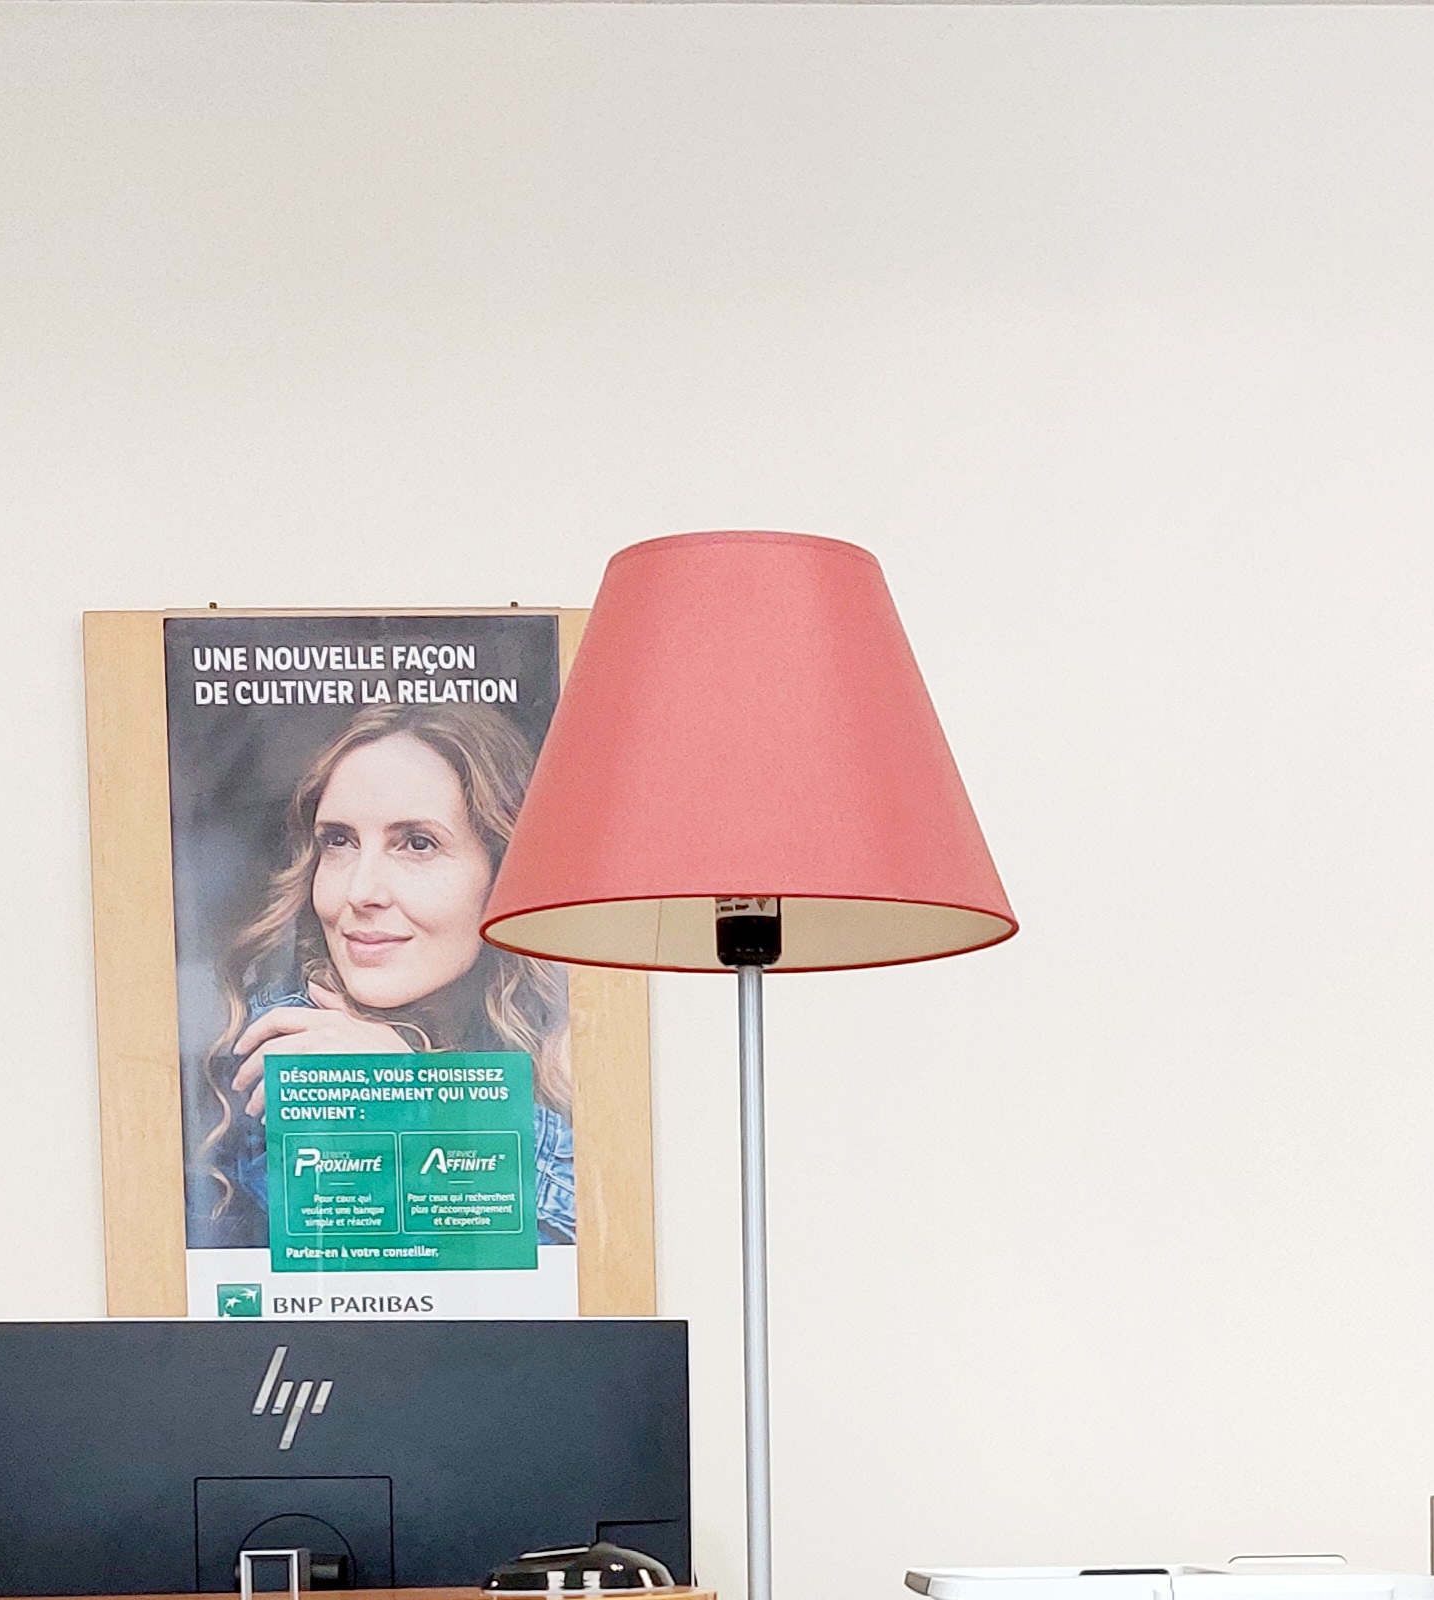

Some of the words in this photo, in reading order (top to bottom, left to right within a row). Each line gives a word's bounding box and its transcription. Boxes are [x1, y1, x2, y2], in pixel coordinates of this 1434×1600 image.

[193, 646, 247, 672] UNE
[255, 645, 386, 671] NOUVELLE
[392, 645, 476, 676] FAÇON
[195, 680, 228, 706] DE
[234, 679, 354, 705] CULTIVER
[362, 680, 390, 704] LA
[397, 678, 518, 704] RELATION
[280, 1066, 370, 1085] DÉSORMAIS,
[373, 1068, 415, 1083] VOUS
[418, 1068, 504, 1083] CHOISISSEZ
[280, 1086, 434, 1102] L'ACCOMPAGNEMENT
[438, 1086, 465, 1103] QUI
[469, 1086, 509, 1100] VOUS
[280, 1106, 357, 1120] CONVIENT
[294, 1148, 383, 1177] PROXIMITÉ
[420, 1147, 497, 1175] AFFINITÉ
[314, 1194, 334, 1204] Pour
[358, 1194, 372, 1206] qui
[407, 1193, 427, 1203] Pour
[450, 1193, 463, 1205] qui
[465, 1192, 516, 1202] recherchent
[411, 1205, 429, 1215] plus
[336, 1218, 345, 1227] et
[347, 1217, 382, 1226] réactive
[433, 1216, 443, 1225] et
[286, 1247, 338, 1258] Parlez-en
[341, 1245, 347, 1257] à
[350, 1247, 380, 1257] votre
[273, 1297, 323, 1314] BNP
[331, 1296, 434, 1313] PARIBAS
[251, 1345, 333, 1450] hp
